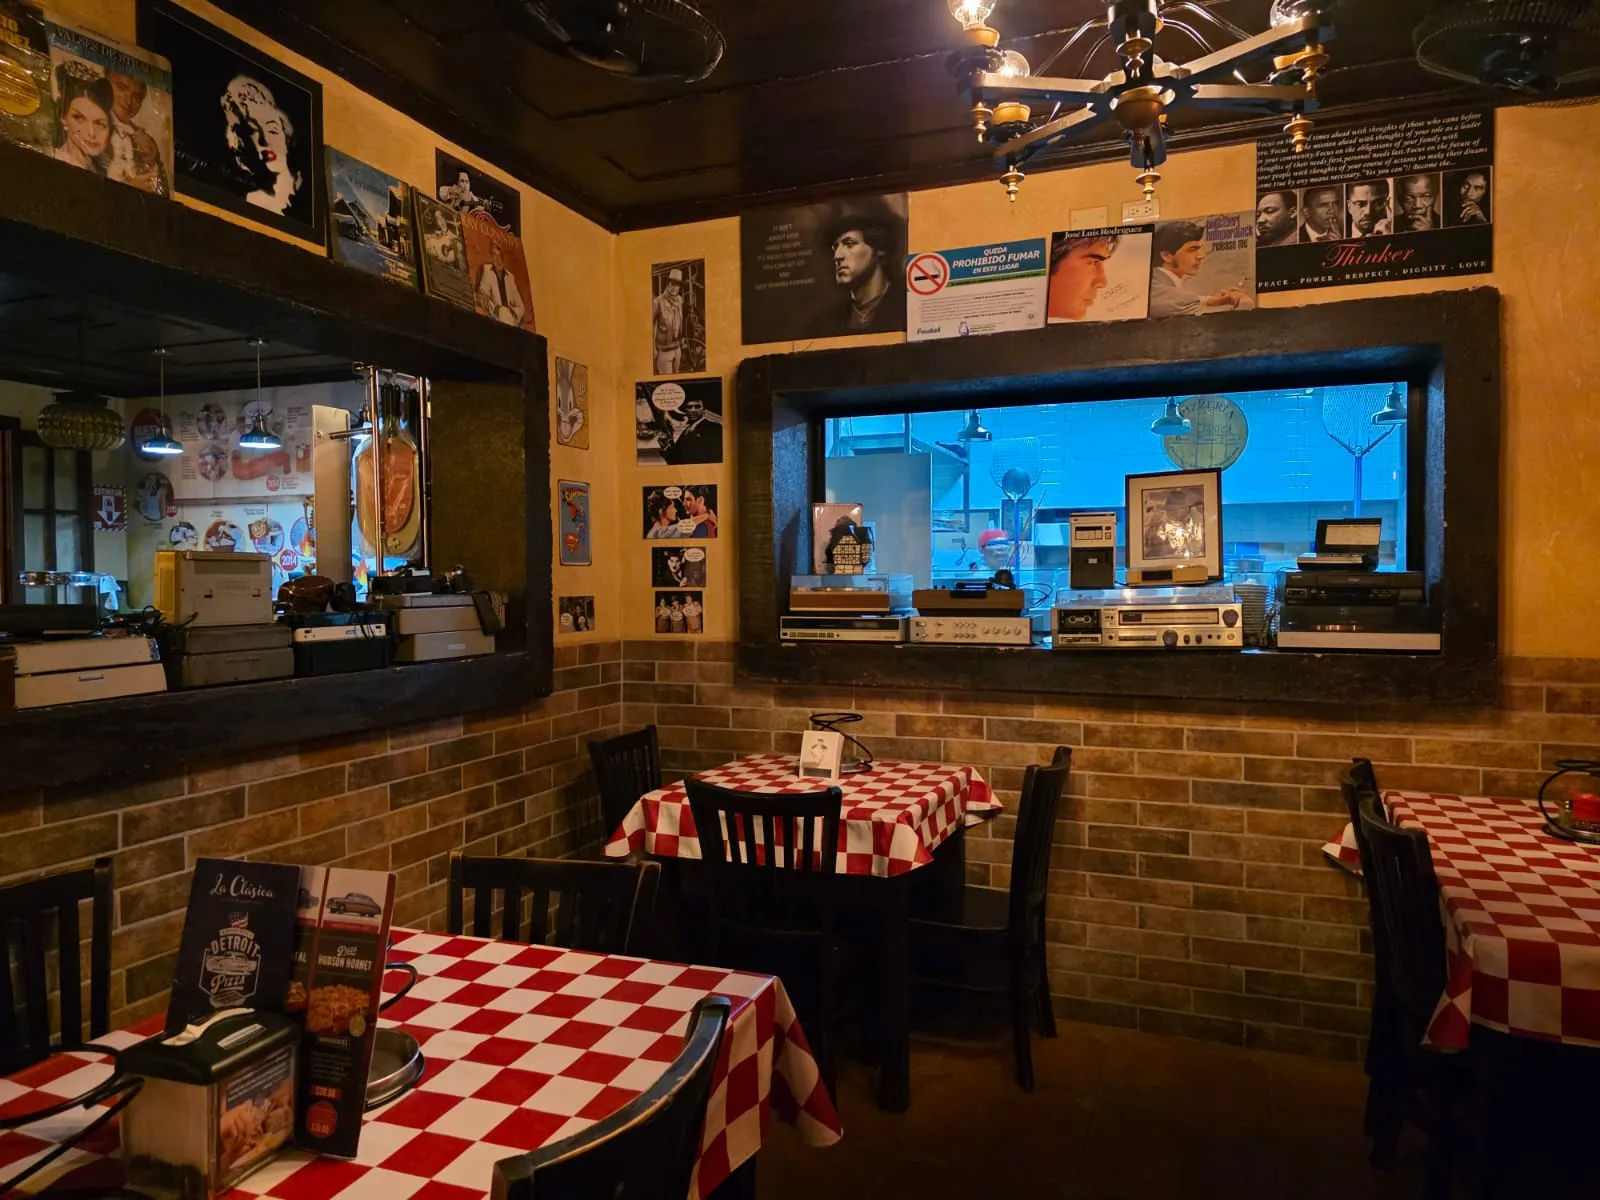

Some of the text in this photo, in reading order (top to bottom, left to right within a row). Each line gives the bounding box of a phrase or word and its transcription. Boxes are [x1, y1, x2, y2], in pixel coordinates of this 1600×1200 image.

[57, 29, 98, 51] VALSES
[101, 47, 115, 60] DE
[1368, 124, 1396, 133] thoughts
[1398, 123, 1406, 131] of
[1461, 112, 1481, 121] before
[1337, 137, 1357, 145] ahead
[1375, 131, 1403, 140] thoughts
[1460, 121, 1481, 129] leader
[1356, 141, 1391, 151] obligations
[1393, 139, 1402, 148] of
[1418, 135, 1440, 145] family
[1448, 140, 1470, 149] future
[1472, 137, 1481, 146] of
[1271, 171, 1290, 180] people
[1309, 165, 1337, 175] thoughts
[1338, 164, 1346, 172] of
[1384, 158, 1392, 167] of
[1287, 177, 1294, 186] by
[1377, 168, 1389, 176] you
[1082, 229, 1099, 238] Luis
[952, 250, 1041, 268] PROHIBIDO FUMAR
[984, 247, 1007, 256] QUEDA
[1322, 241, 1417, 269] Thinker
[973, 263, 1019, 274] EN ESTE LUGAR
[1258, 260, 1488, 288] PEACE POWER RESPECT DIGNITY LOVE
[281, 554, 297, 566] 2014
[208, 872, 275, 899] La Clásica
[211, 935, 261, 957] DETROIT
[318, 954, 373, 971] HUDSON HORNET
